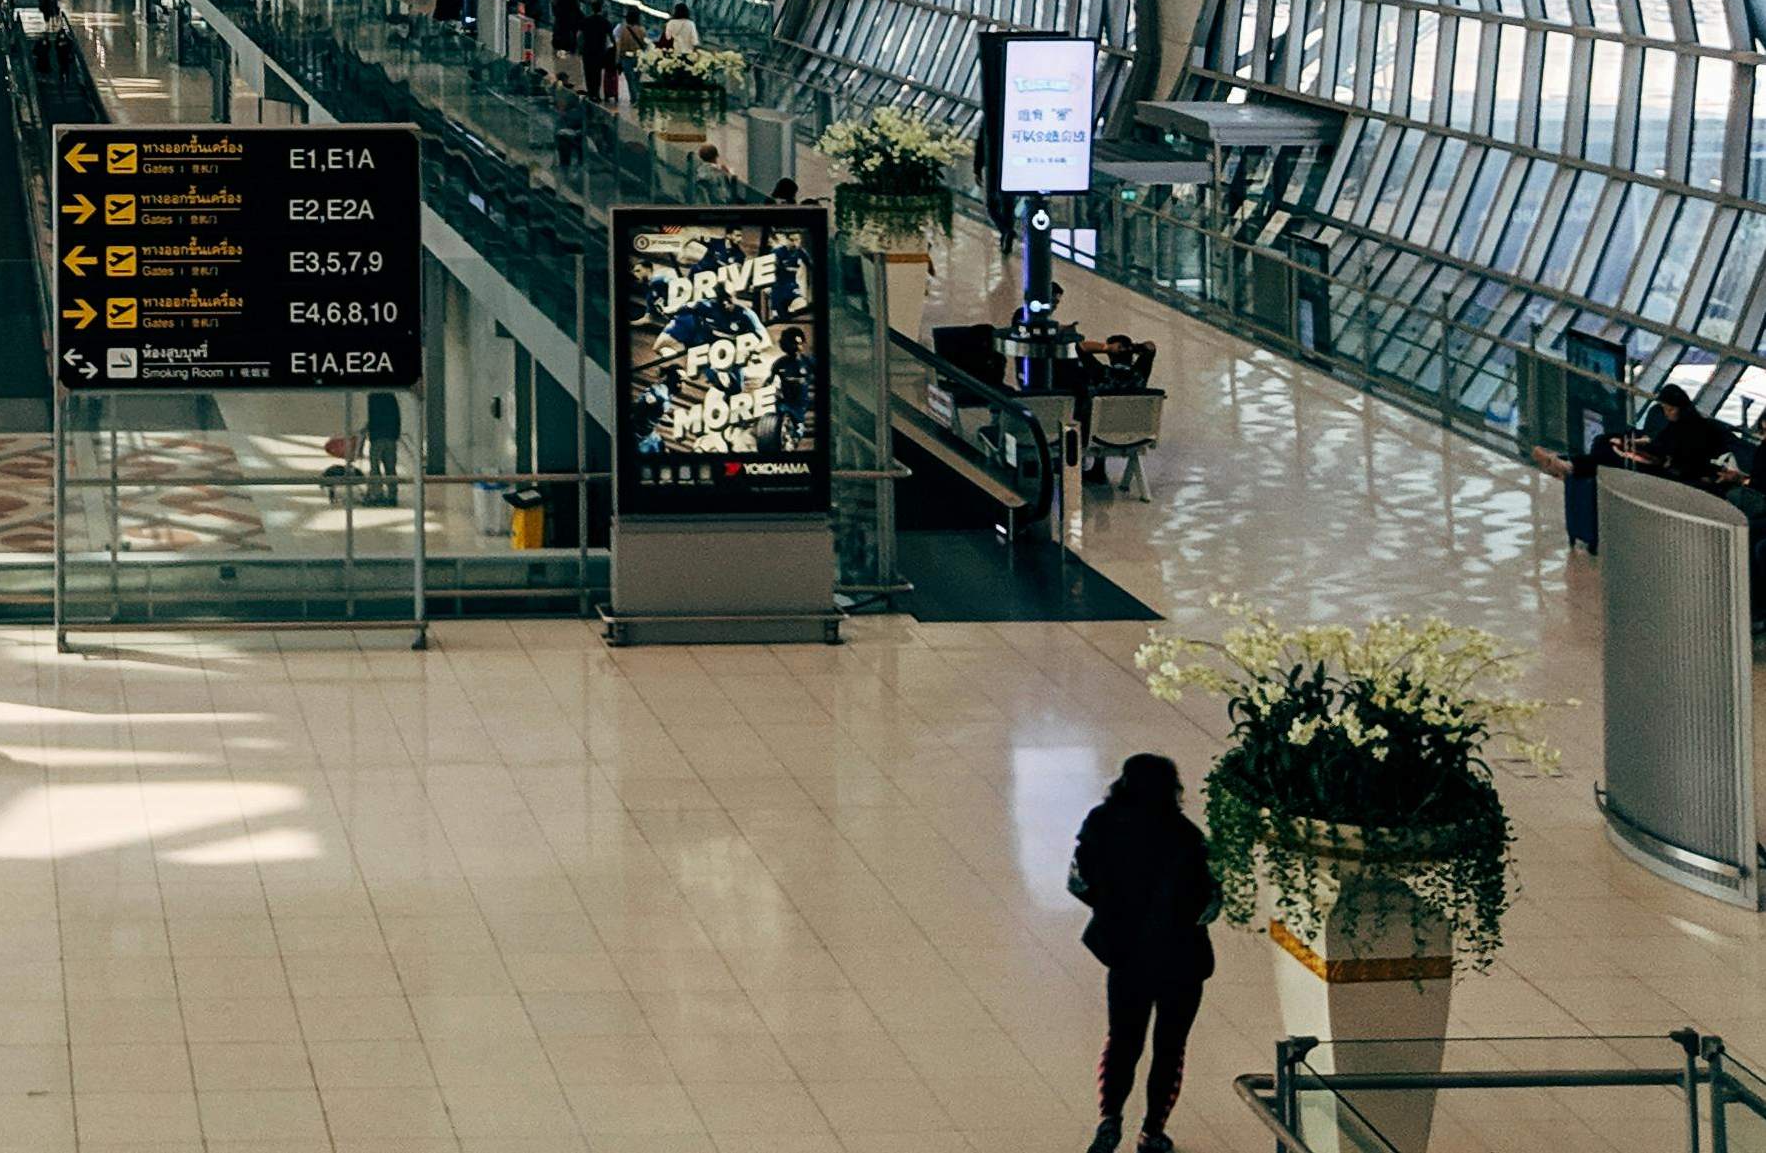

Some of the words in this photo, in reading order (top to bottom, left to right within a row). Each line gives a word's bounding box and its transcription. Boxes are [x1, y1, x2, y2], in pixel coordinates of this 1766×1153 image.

[142, 163, 175, 175] Gates
[289, 148, 375, 172] E1,E1A
[140, 213, 174, 226] Gates
[289, 199, 375, 223] E2,E2A
[141, 265, 175, 277] Gates
[289, 251, 383, 276] E3,5,7,9
[665, 254, 777, 314] DRIVE
[142, 317, 175, 329] Gates
[289, 301, 398, 326] E4,6,8,10
[142, 367, 188, 381] Smoking
[192, 367, 224, 378] Room
[291, 351, 394, 376] E1A,E2A
[673, 384, 778, 440] MORE
[742, 462, 810, 475] YOKOHAMA
